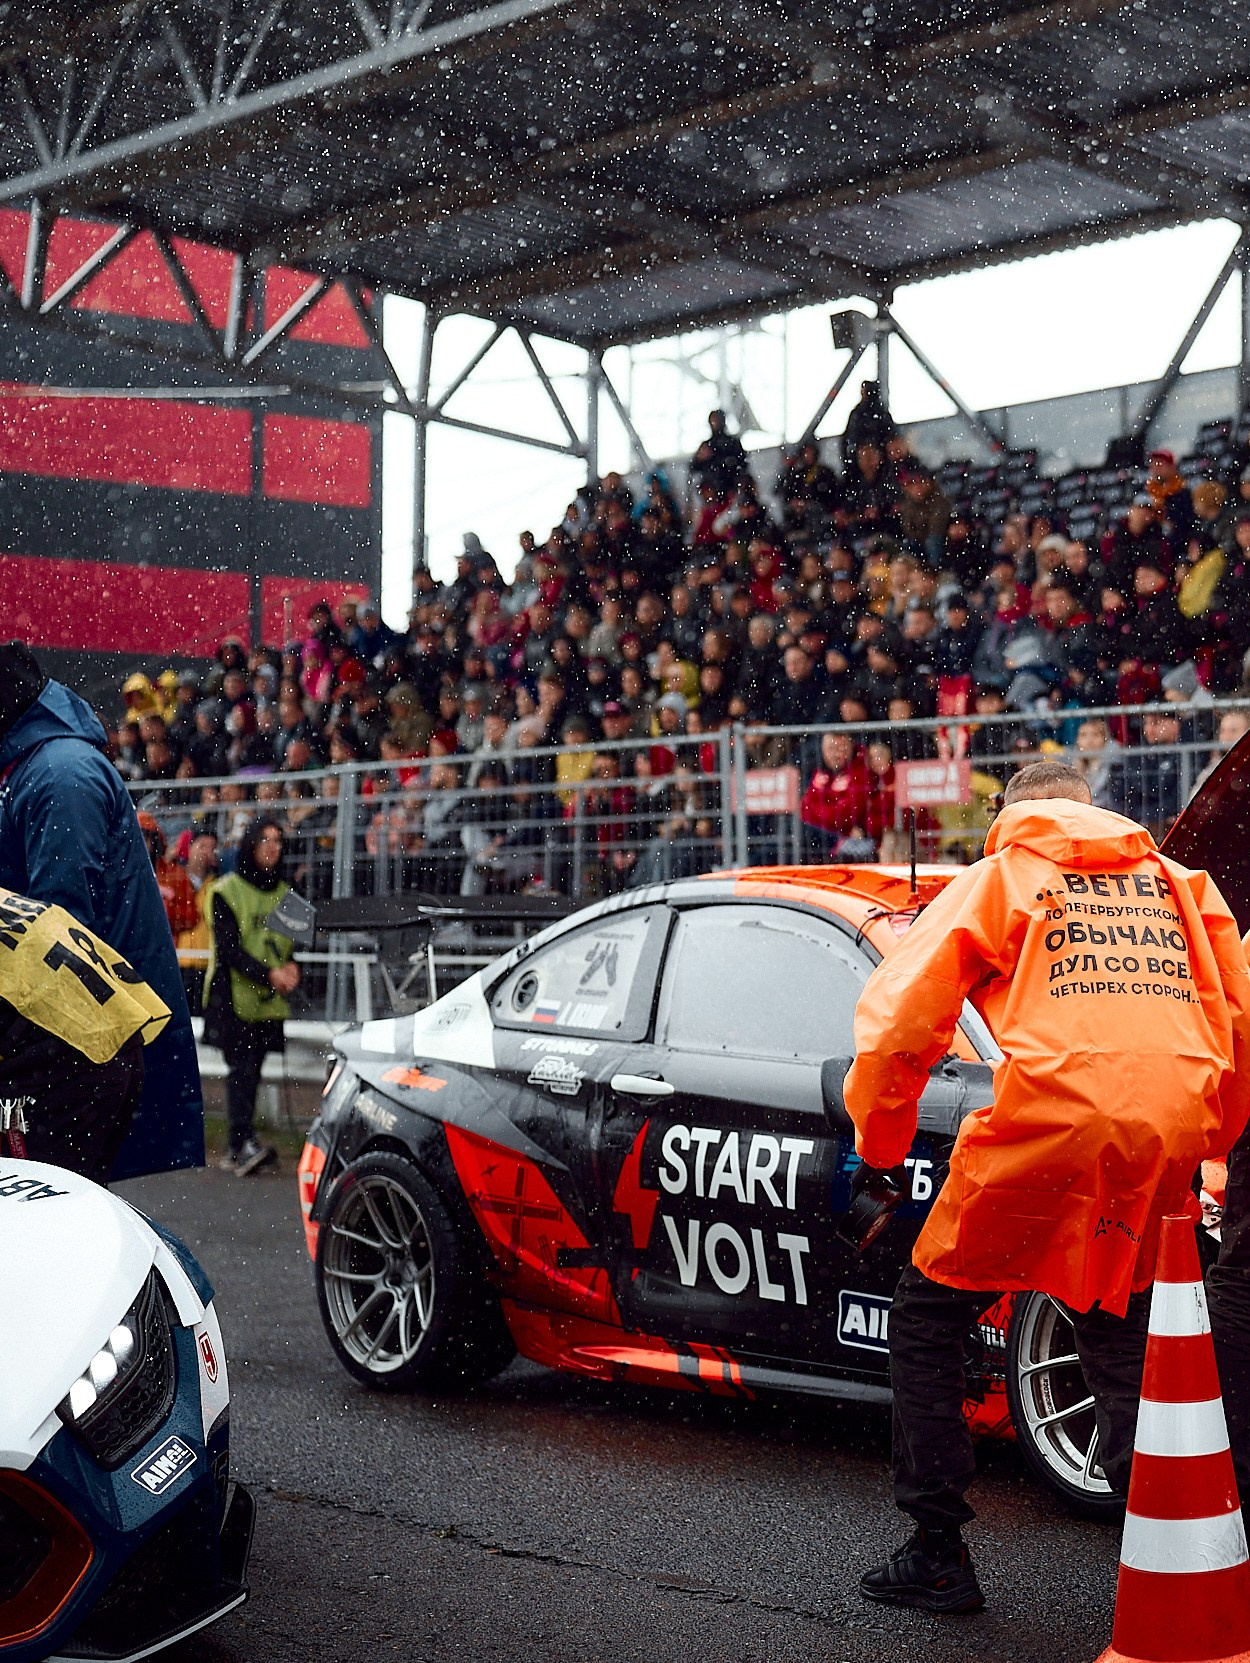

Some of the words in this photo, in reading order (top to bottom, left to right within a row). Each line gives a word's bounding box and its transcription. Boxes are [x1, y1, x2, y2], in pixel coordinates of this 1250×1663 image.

[1045, 921, 1187, 953] ОБЫЧАЮ
[1048, 954, 1099, 983] ДУЛ
[1105, 956, 1140, 973] СО
[1050, 981, 1128, 999] ЧЕТЫРЕХ
[658, 1123, 815, 1210] START
[662, 1214, 811, 1306] VOLT
